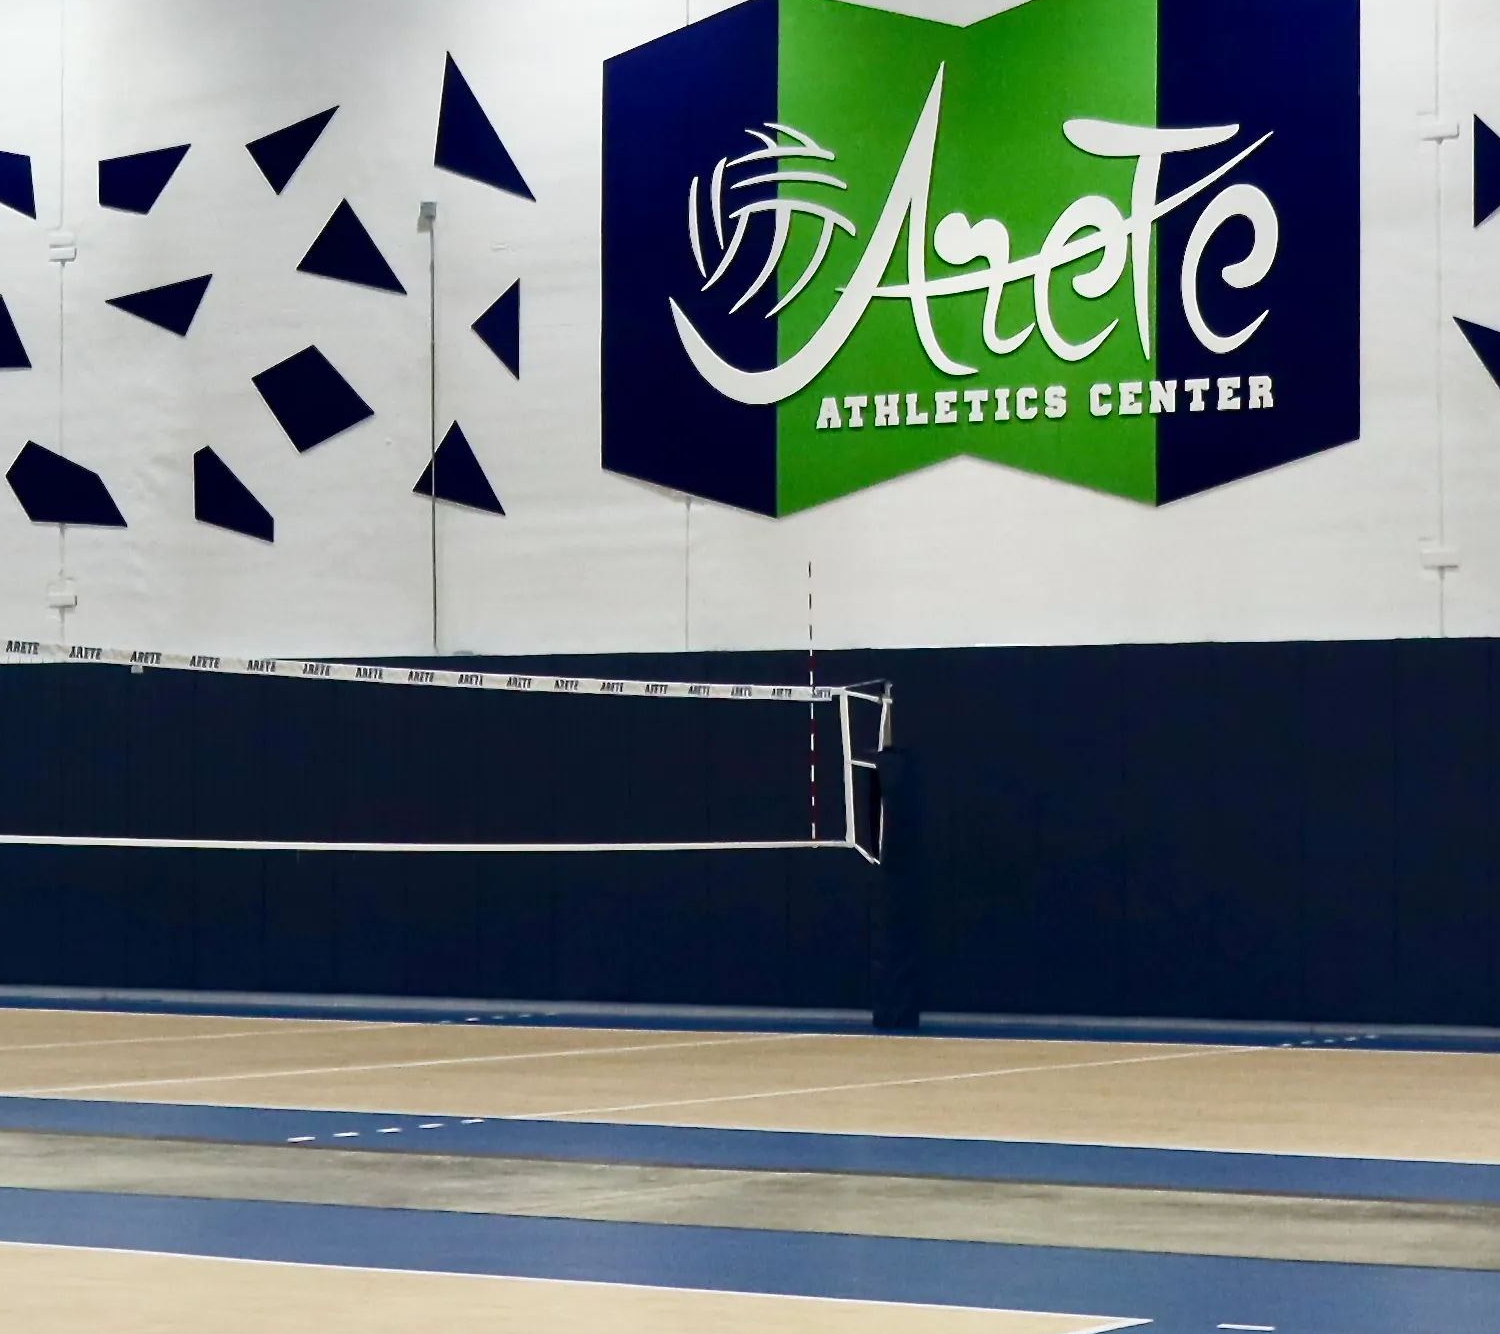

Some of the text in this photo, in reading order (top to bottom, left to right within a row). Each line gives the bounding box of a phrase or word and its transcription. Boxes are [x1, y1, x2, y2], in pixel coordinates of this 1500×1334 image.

[815, 375, 1274, 429] ATHLETICS CENTER
[6, 640, 39, 655] ARETE
[130, 650, 162, 665] ARETE
[247, 659, 276, 673] ARETE
